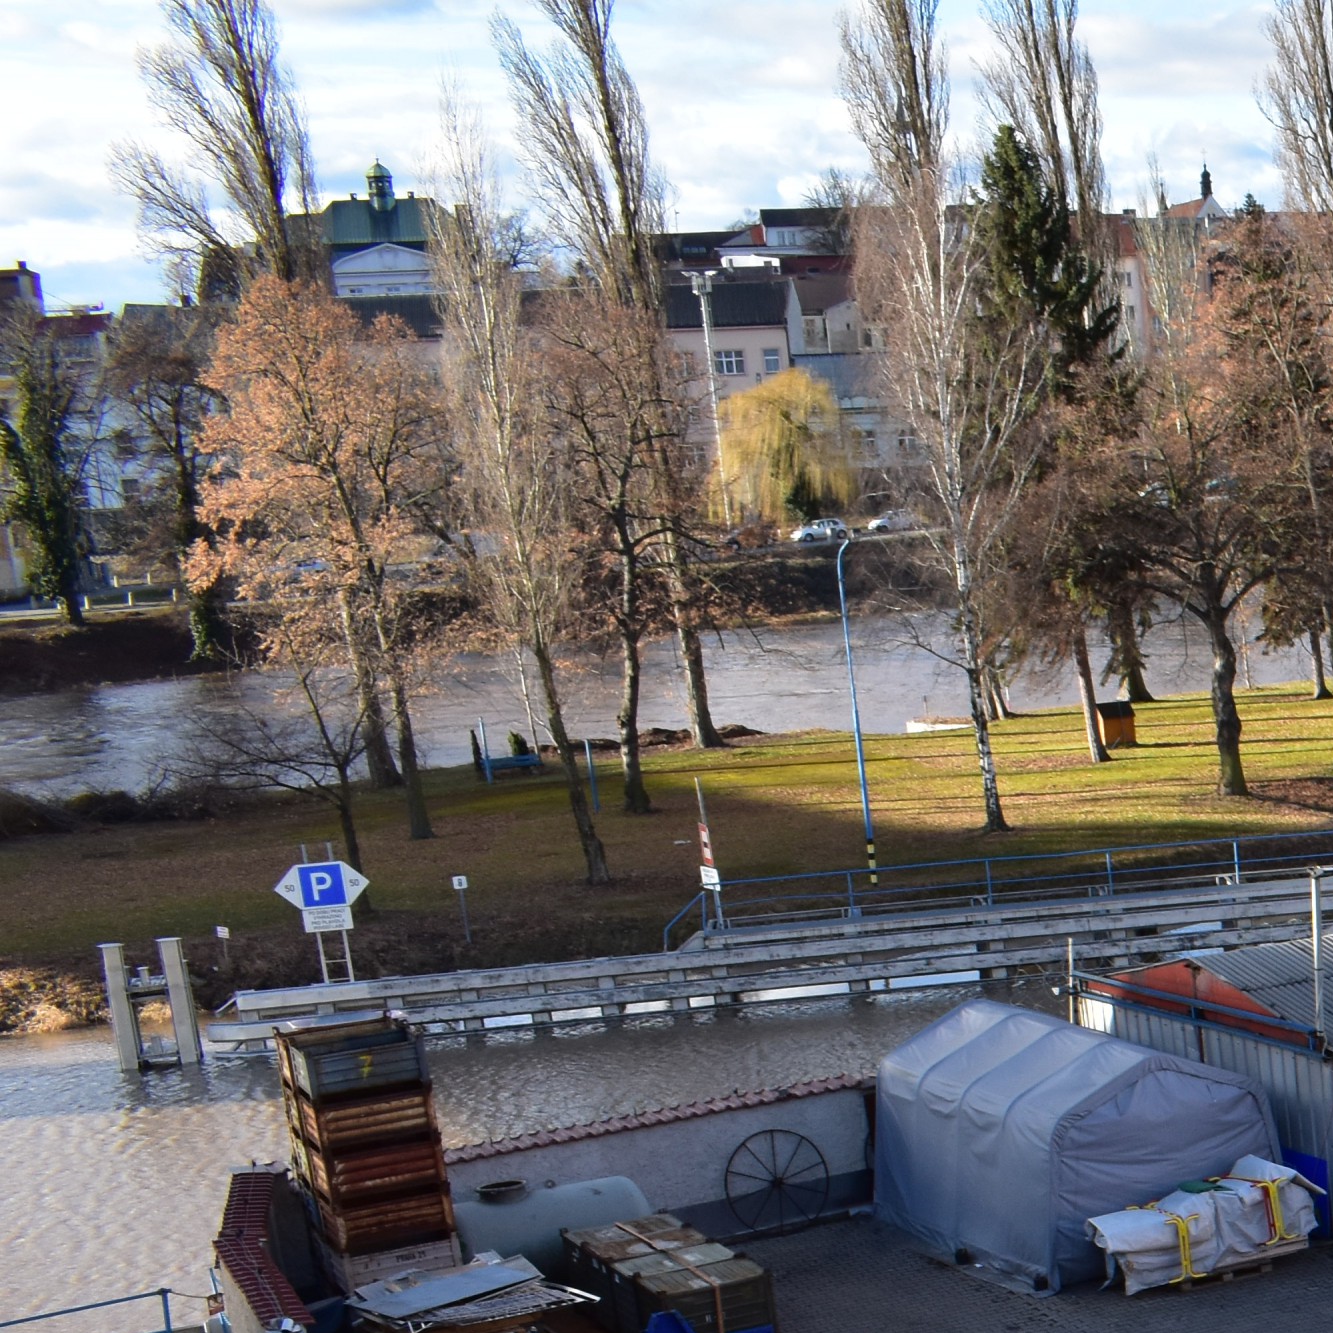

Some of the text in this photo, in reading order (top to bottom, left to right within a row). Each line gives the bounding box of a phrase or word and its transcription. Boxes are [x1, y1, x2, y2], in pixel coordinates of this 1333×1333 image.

[284, 871, 360, 902] 50 P 50
[359, 1054, 373, 1079] 7
